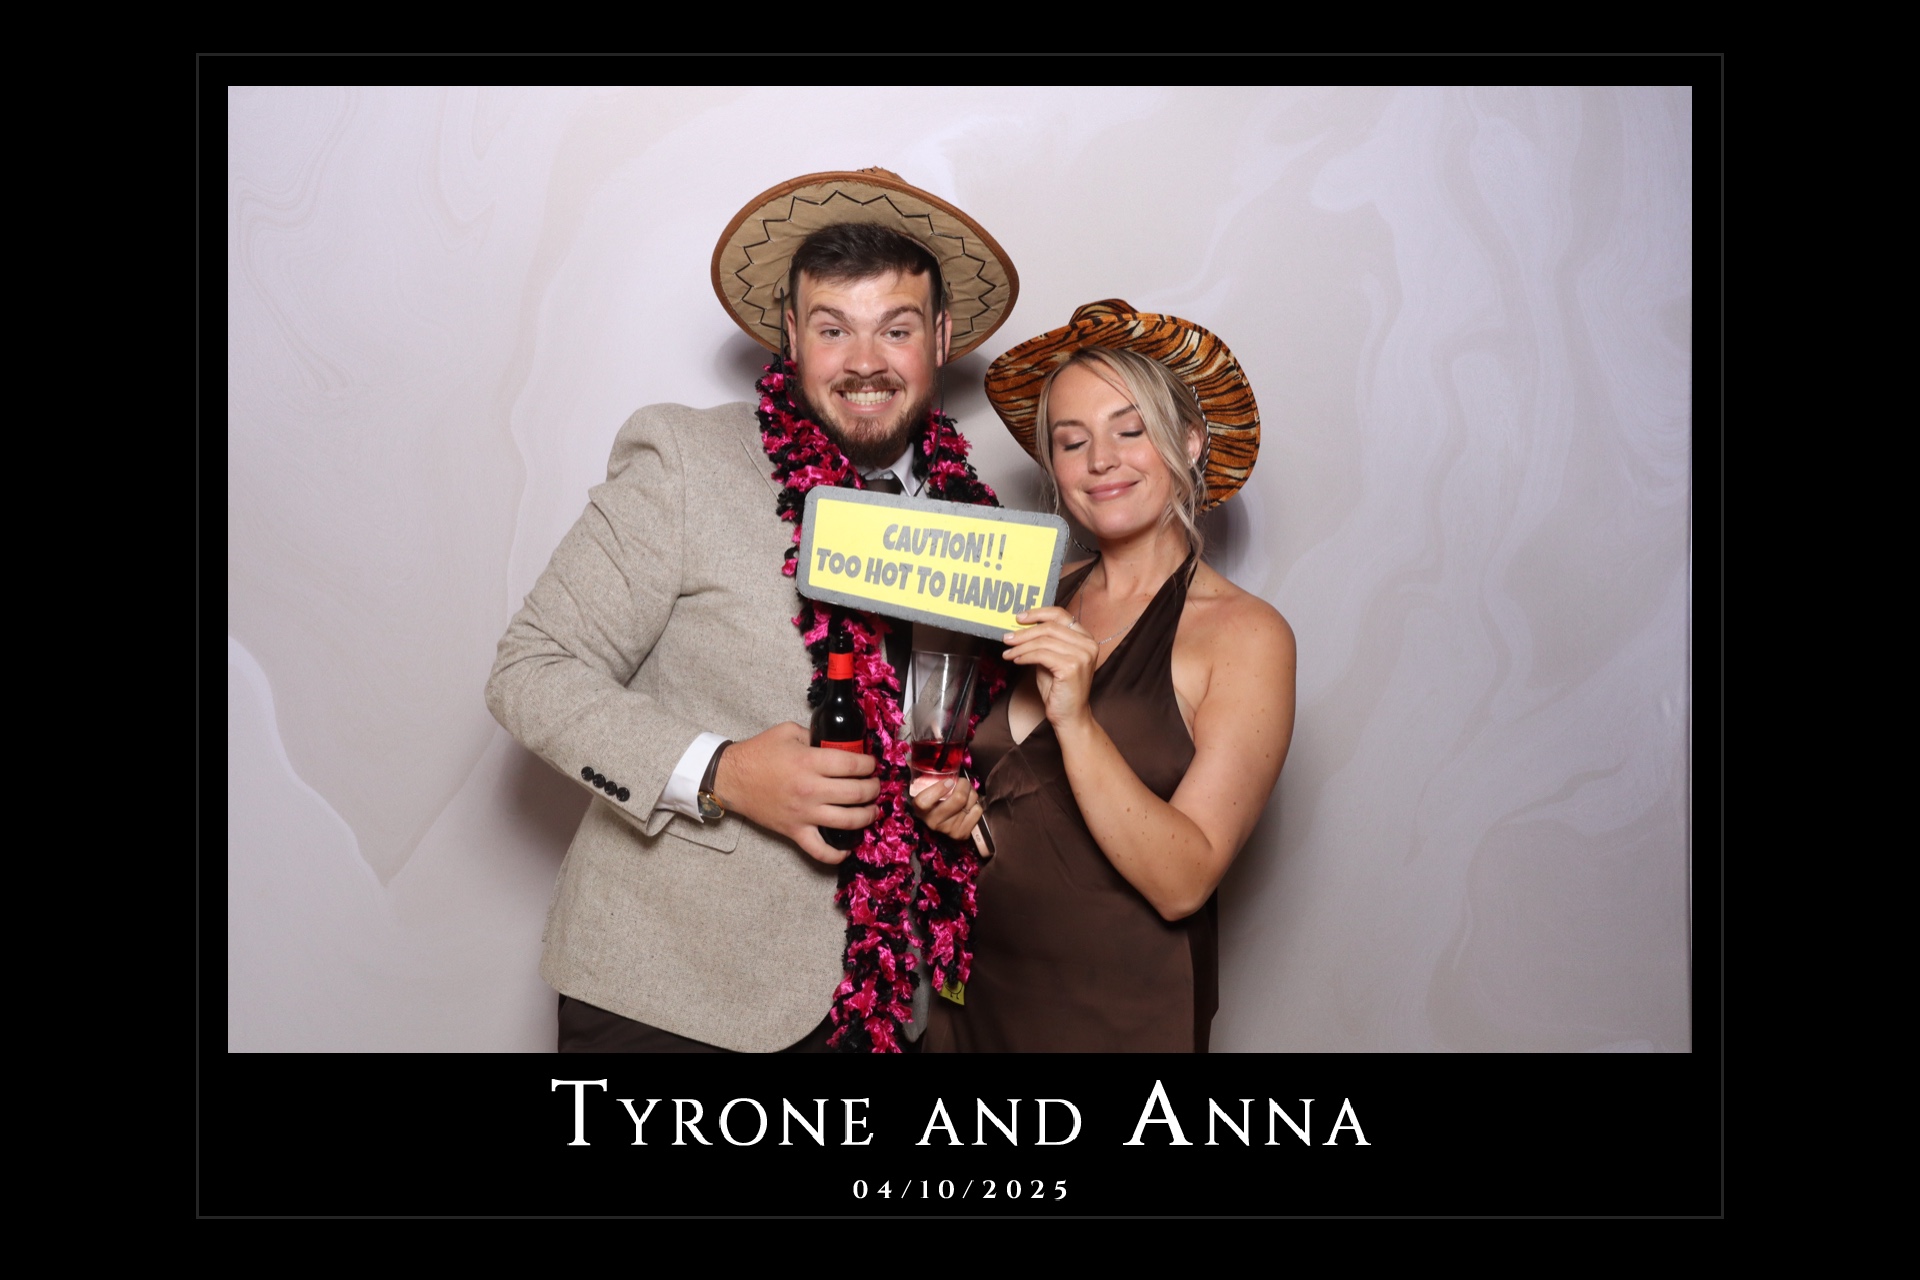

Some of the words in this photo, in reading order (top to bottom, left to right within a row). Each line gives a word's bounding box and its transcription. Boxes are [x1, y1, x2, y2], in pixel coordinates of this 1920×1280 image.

[882, 523, 1007, 571] CAUTION!!
[816, 547, 862, 578] TOO
[864, 557, 914, 590] HOT
[917, 565, 947, 598] TO
[948, 572, 1041, 616] HANDLE
